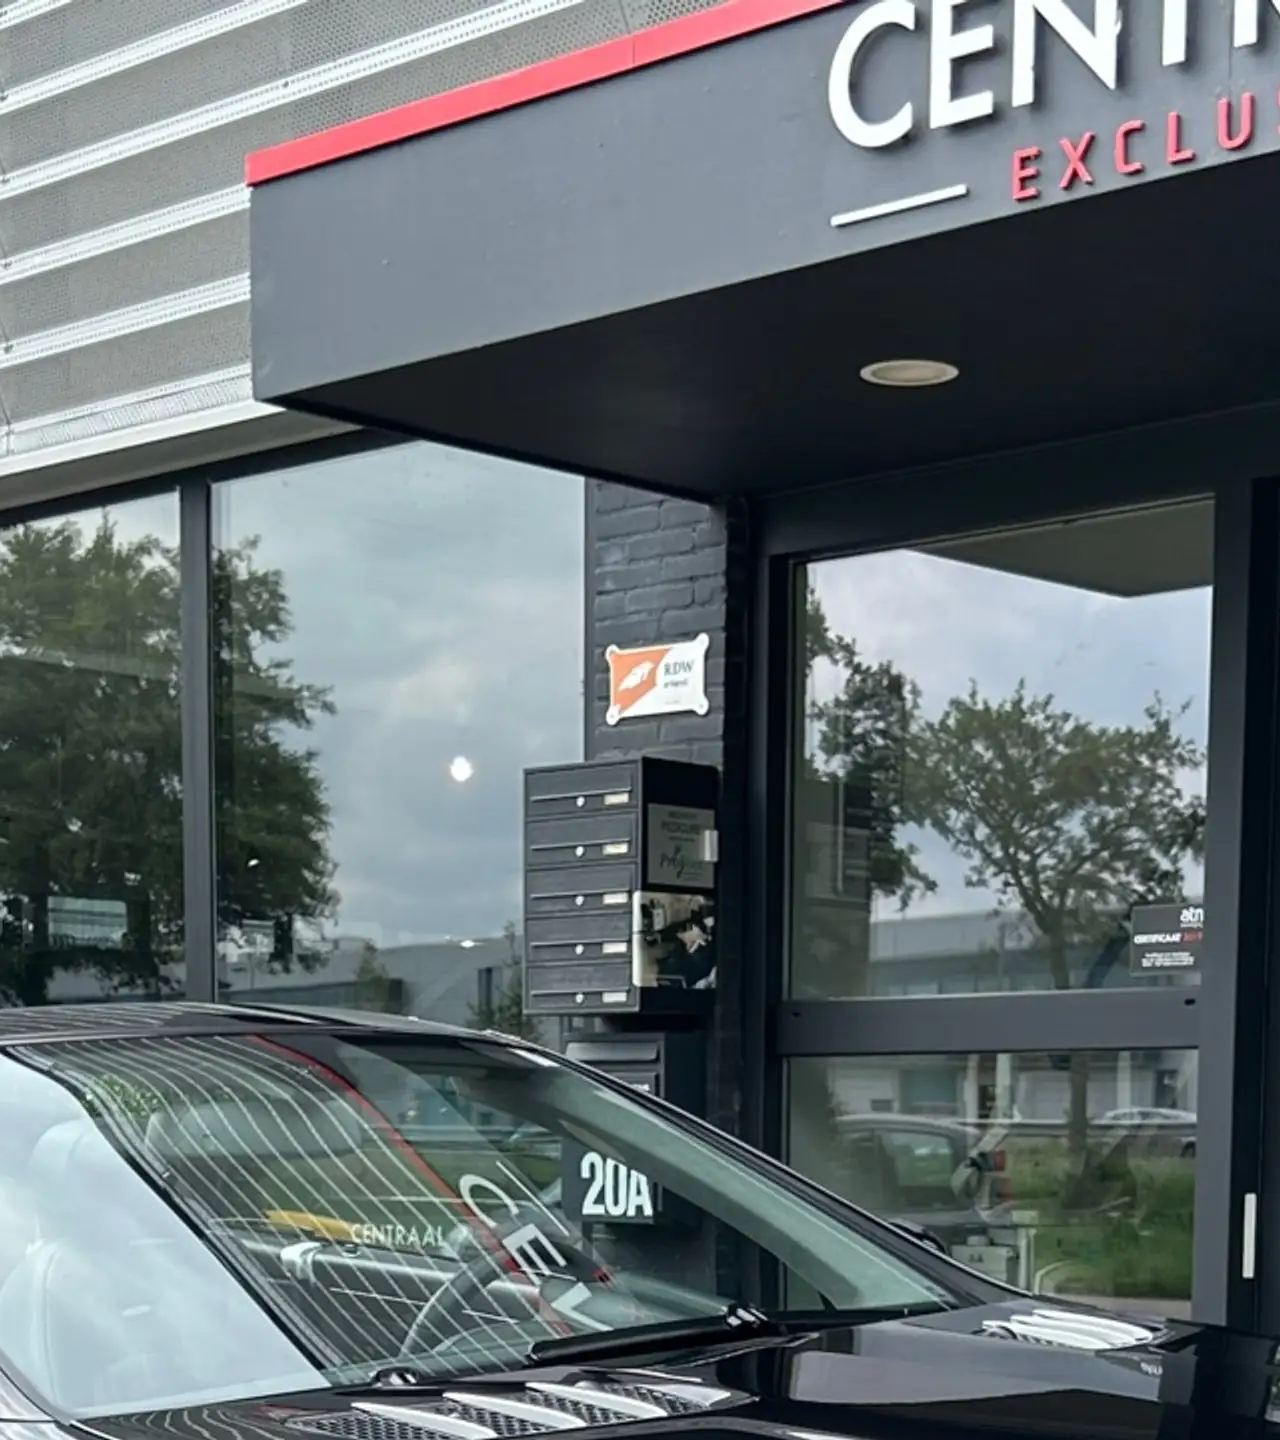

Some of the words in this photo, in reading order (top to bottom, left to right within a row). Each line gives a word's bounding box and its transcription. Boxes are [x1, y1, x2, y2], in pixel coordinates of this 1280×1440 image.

[663, 659, 696, 677] RDW
[580, 1151, 654, 1218] 20A
[350, 1223, 446, 1247] CENTRAAL
